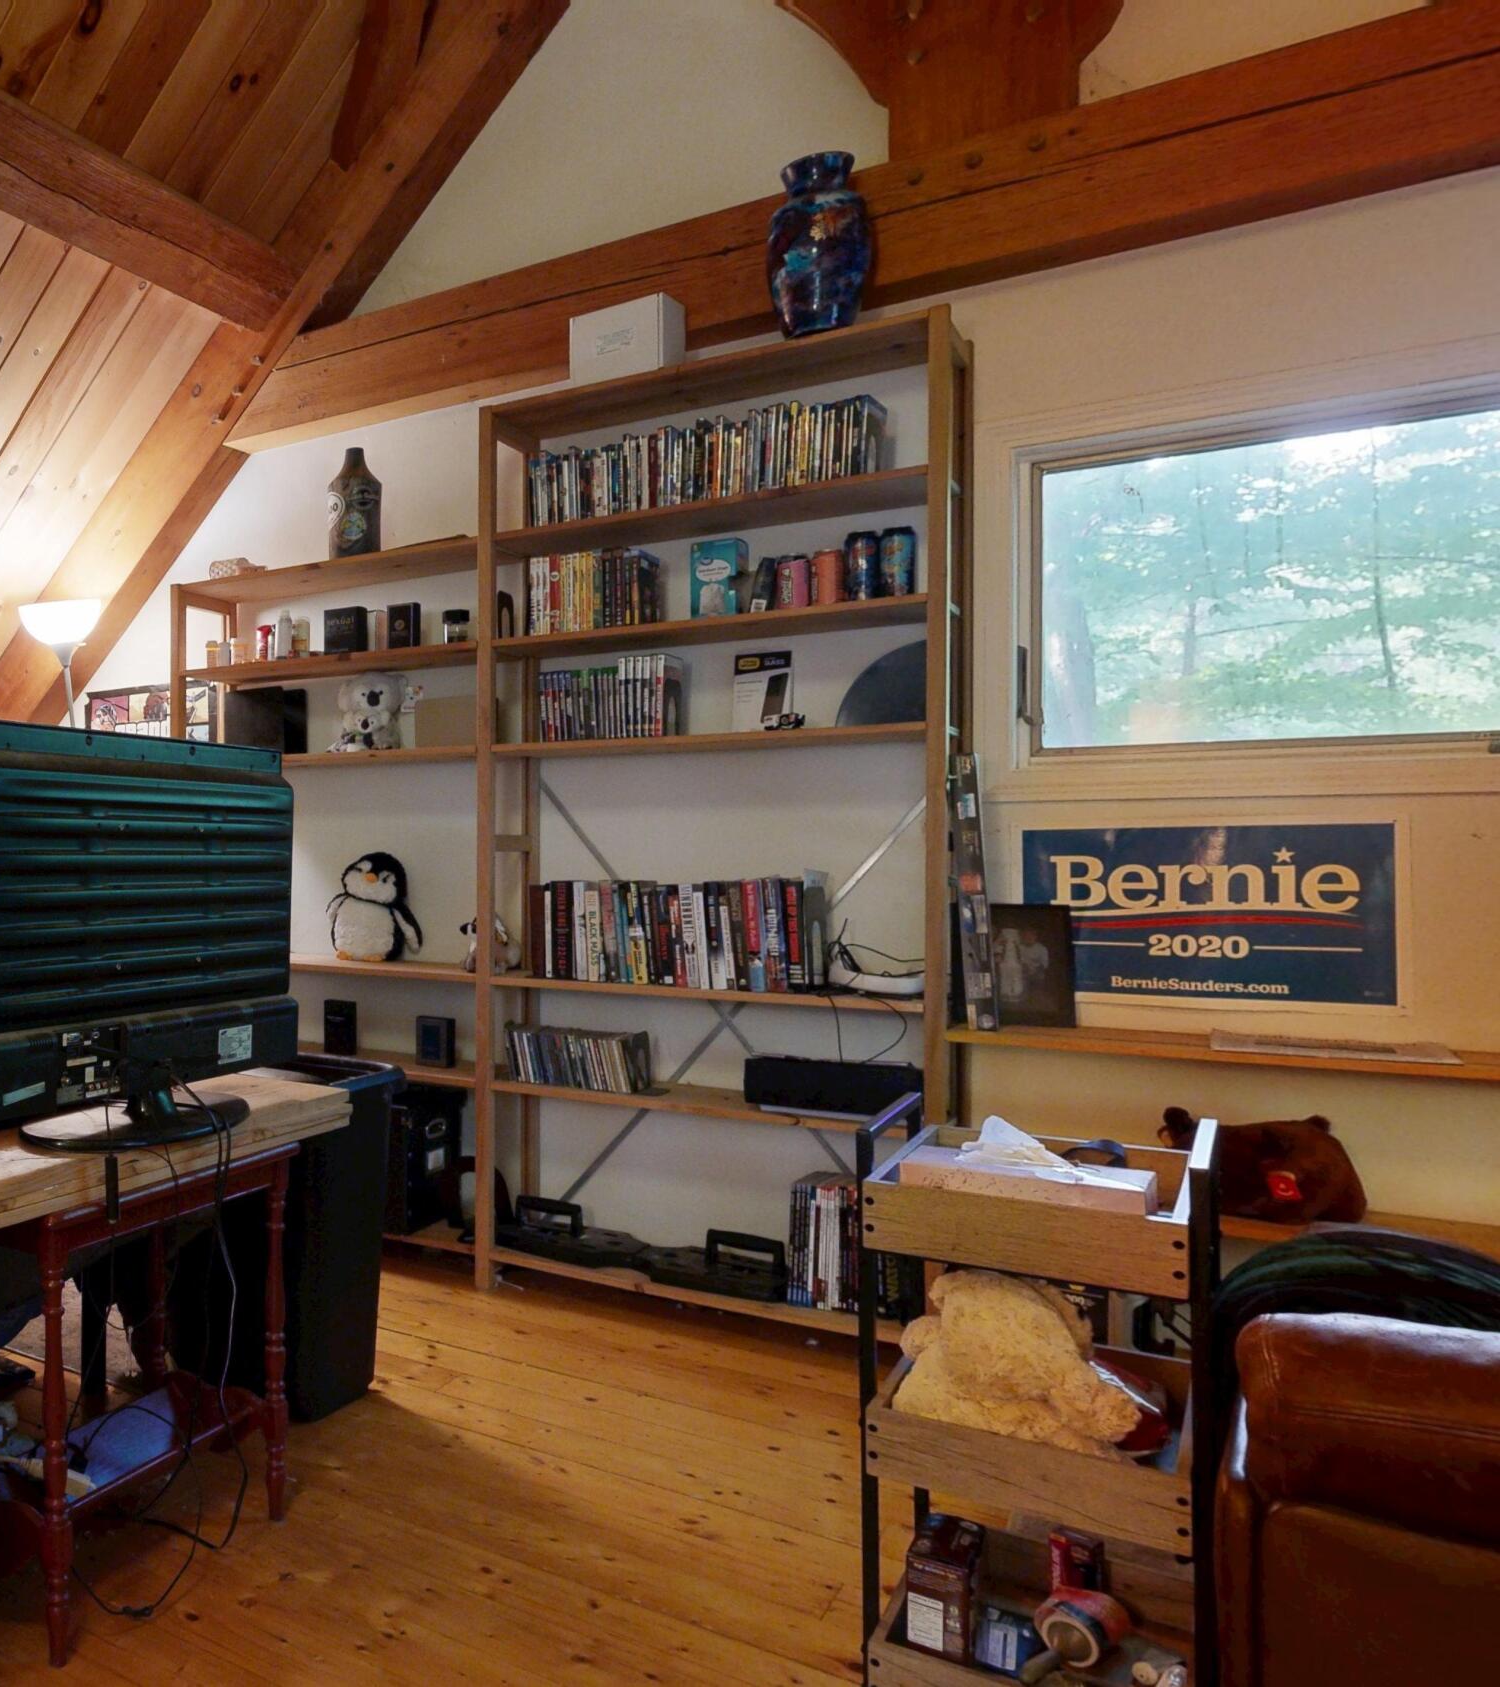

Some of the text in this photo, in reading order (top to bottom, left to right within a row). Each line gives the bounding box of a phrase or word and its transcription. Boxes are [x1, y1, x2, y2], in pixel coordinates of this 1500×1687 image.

[1049, 848, 1361, 911] Bernie
[588, 910, 599, 939] BLACK
[590, 941, 599, 966] MASS
[1148, 933, 1251, 959] 2020
[1110, 975, 1291, 994] BernieSanders.com
[886, 1256, 900, 1303] WATC
